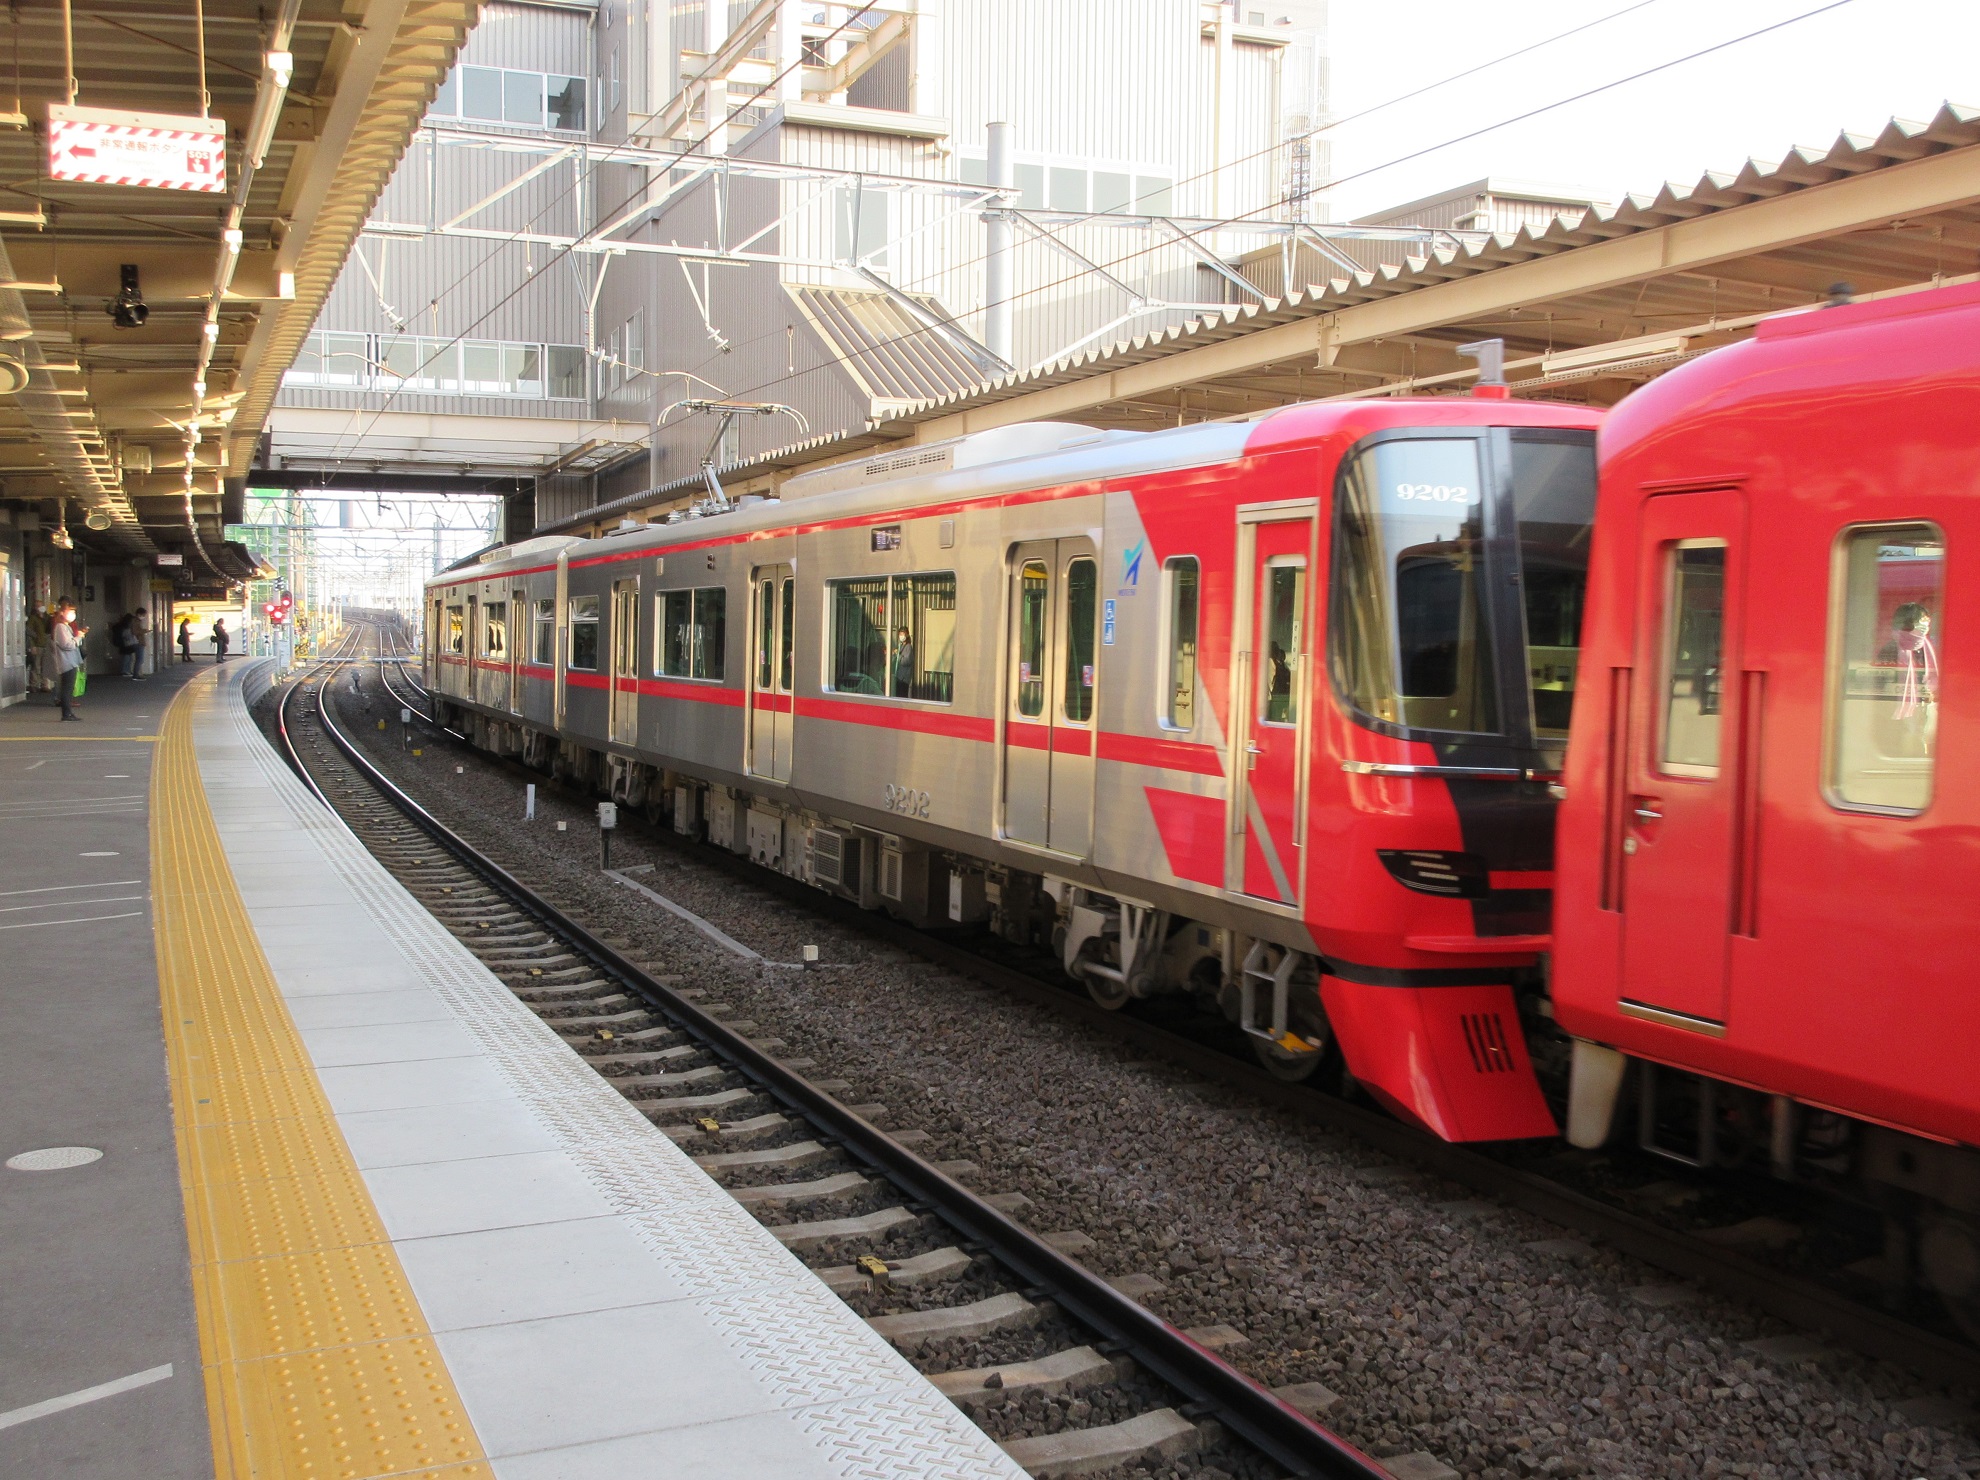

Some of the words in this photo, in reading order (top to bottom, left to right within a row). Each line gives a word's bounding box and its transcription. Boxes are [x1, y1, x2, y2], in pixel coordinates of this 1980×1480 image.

[99, 138, 183, 154] 非常通報ボタン
[188, 150, 210, 160] SOS
[1396, 483, 1469, 503] 9202
[884, 783, 931, 819] 9202
